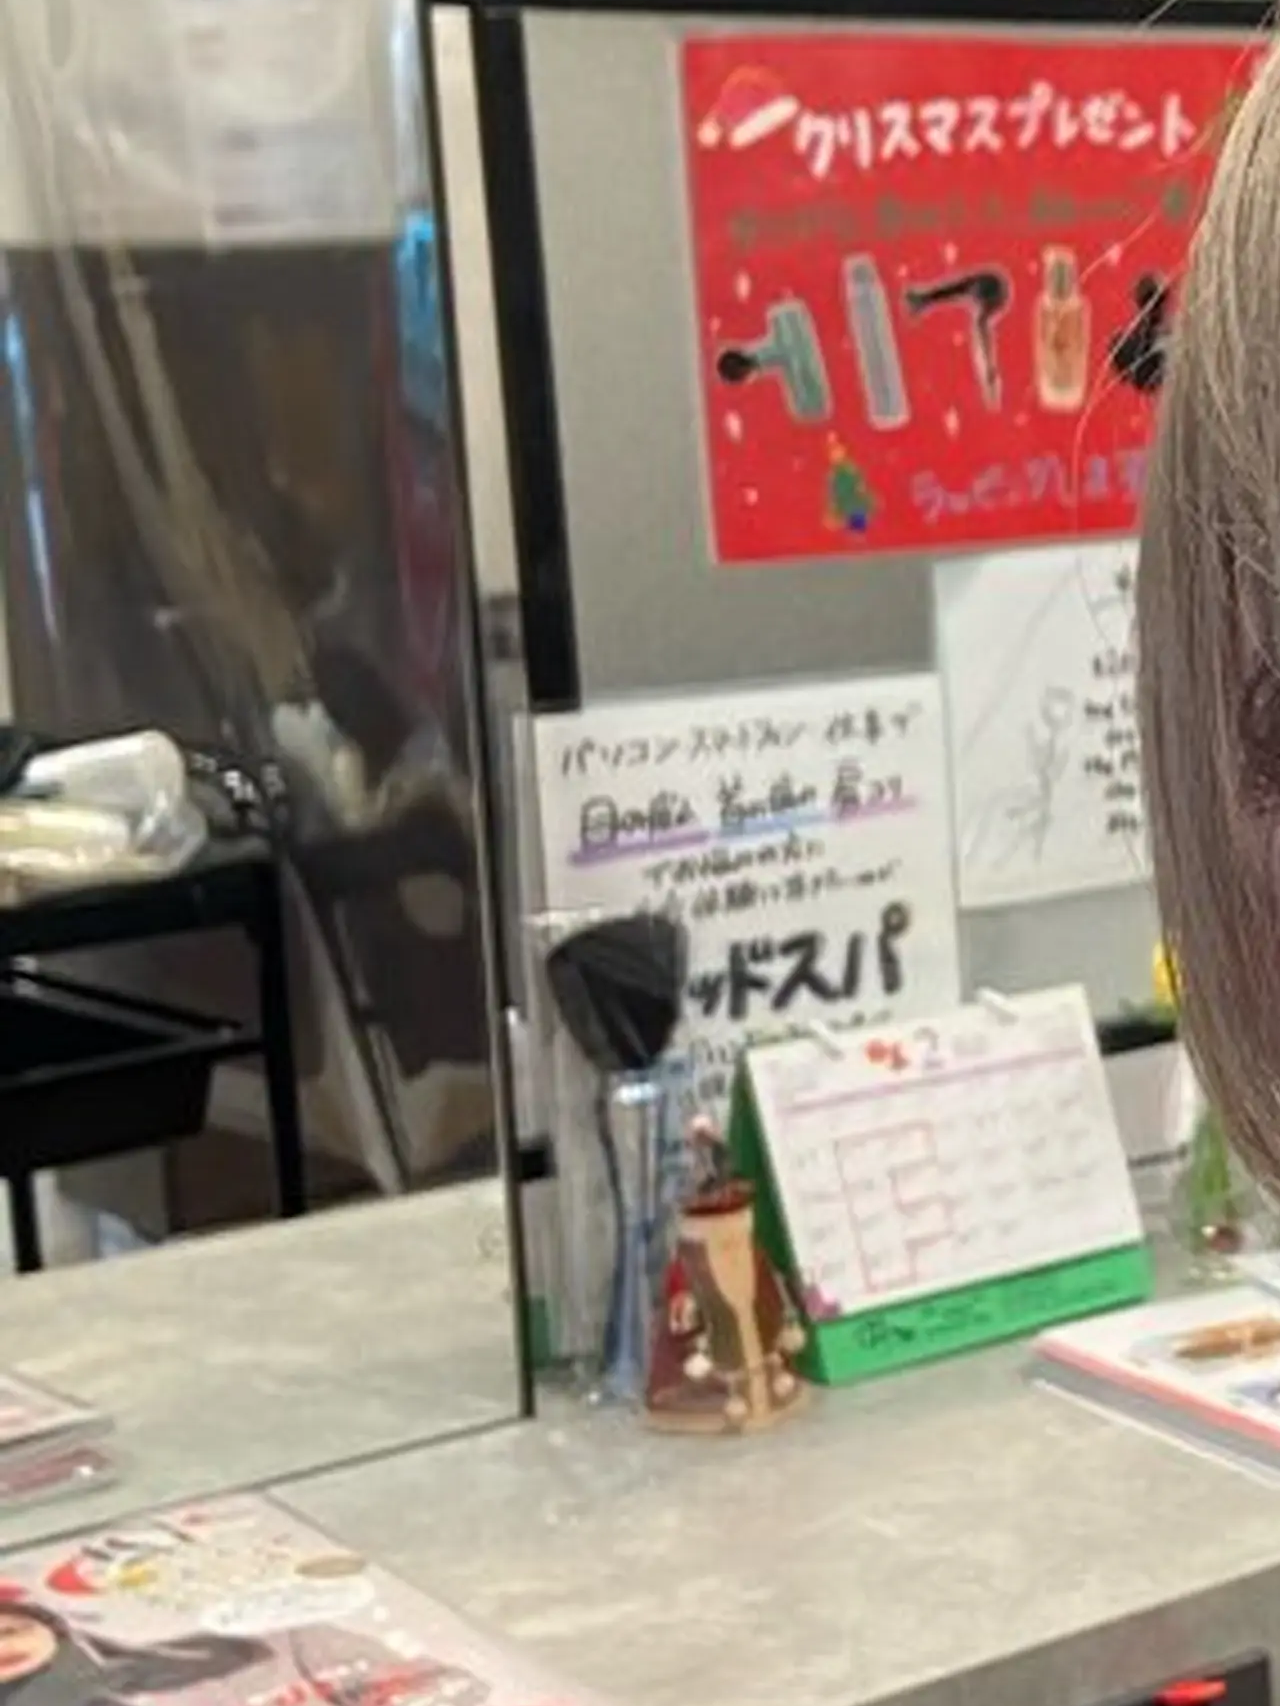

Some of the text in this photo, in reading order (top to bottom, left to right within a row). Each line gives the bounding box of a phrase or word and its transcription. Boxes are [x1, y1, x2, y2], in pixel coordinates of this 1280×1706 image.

[795, 80, 1197, 179] クリスマスプレゼント
[687, 899, 911, 1020] ッドスパ
